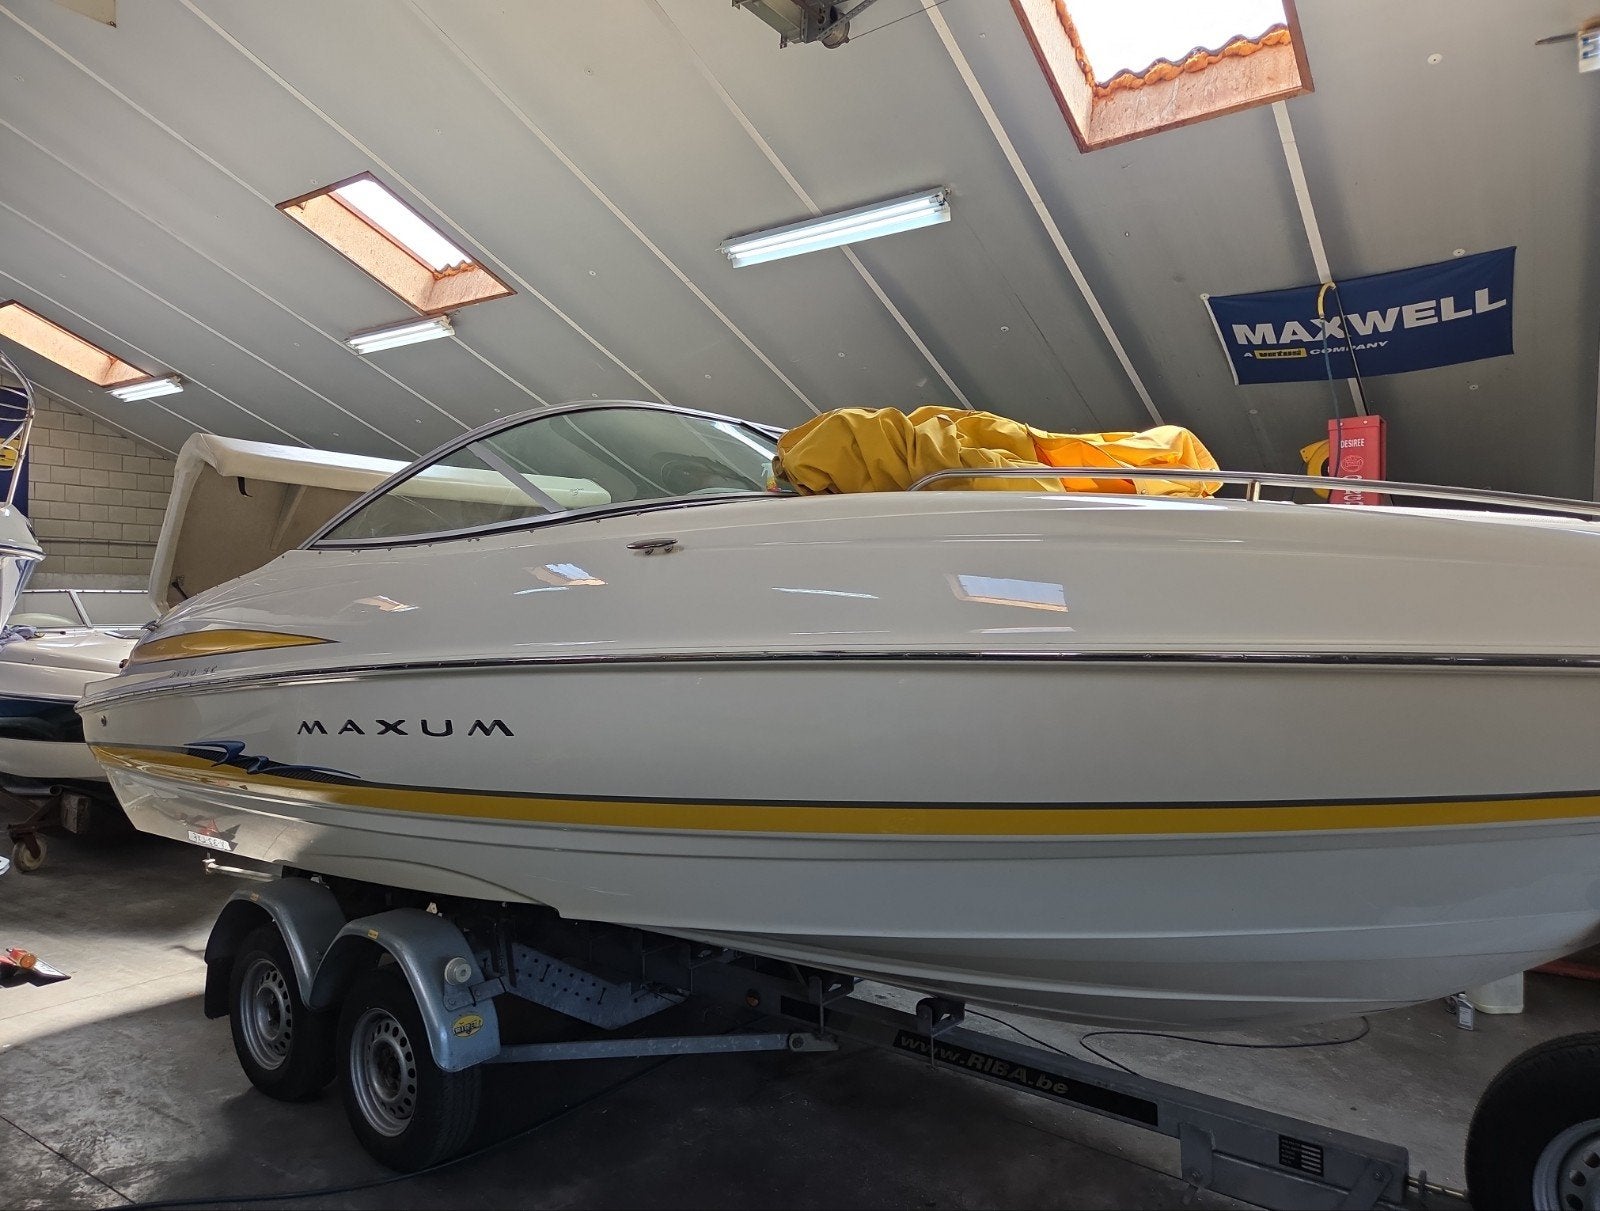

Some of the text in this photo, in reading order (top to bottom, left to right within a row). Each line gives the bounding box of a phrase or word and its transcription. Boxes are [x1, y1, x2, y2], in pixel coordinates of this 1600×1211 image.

[1231, 287, 1507, 345] MAXWELL
[1309, 340, 1389, 355] COMPANY
[1340, 438, 1365, 449] DESIREE
[297, 718, 515, 737] MAXUM
